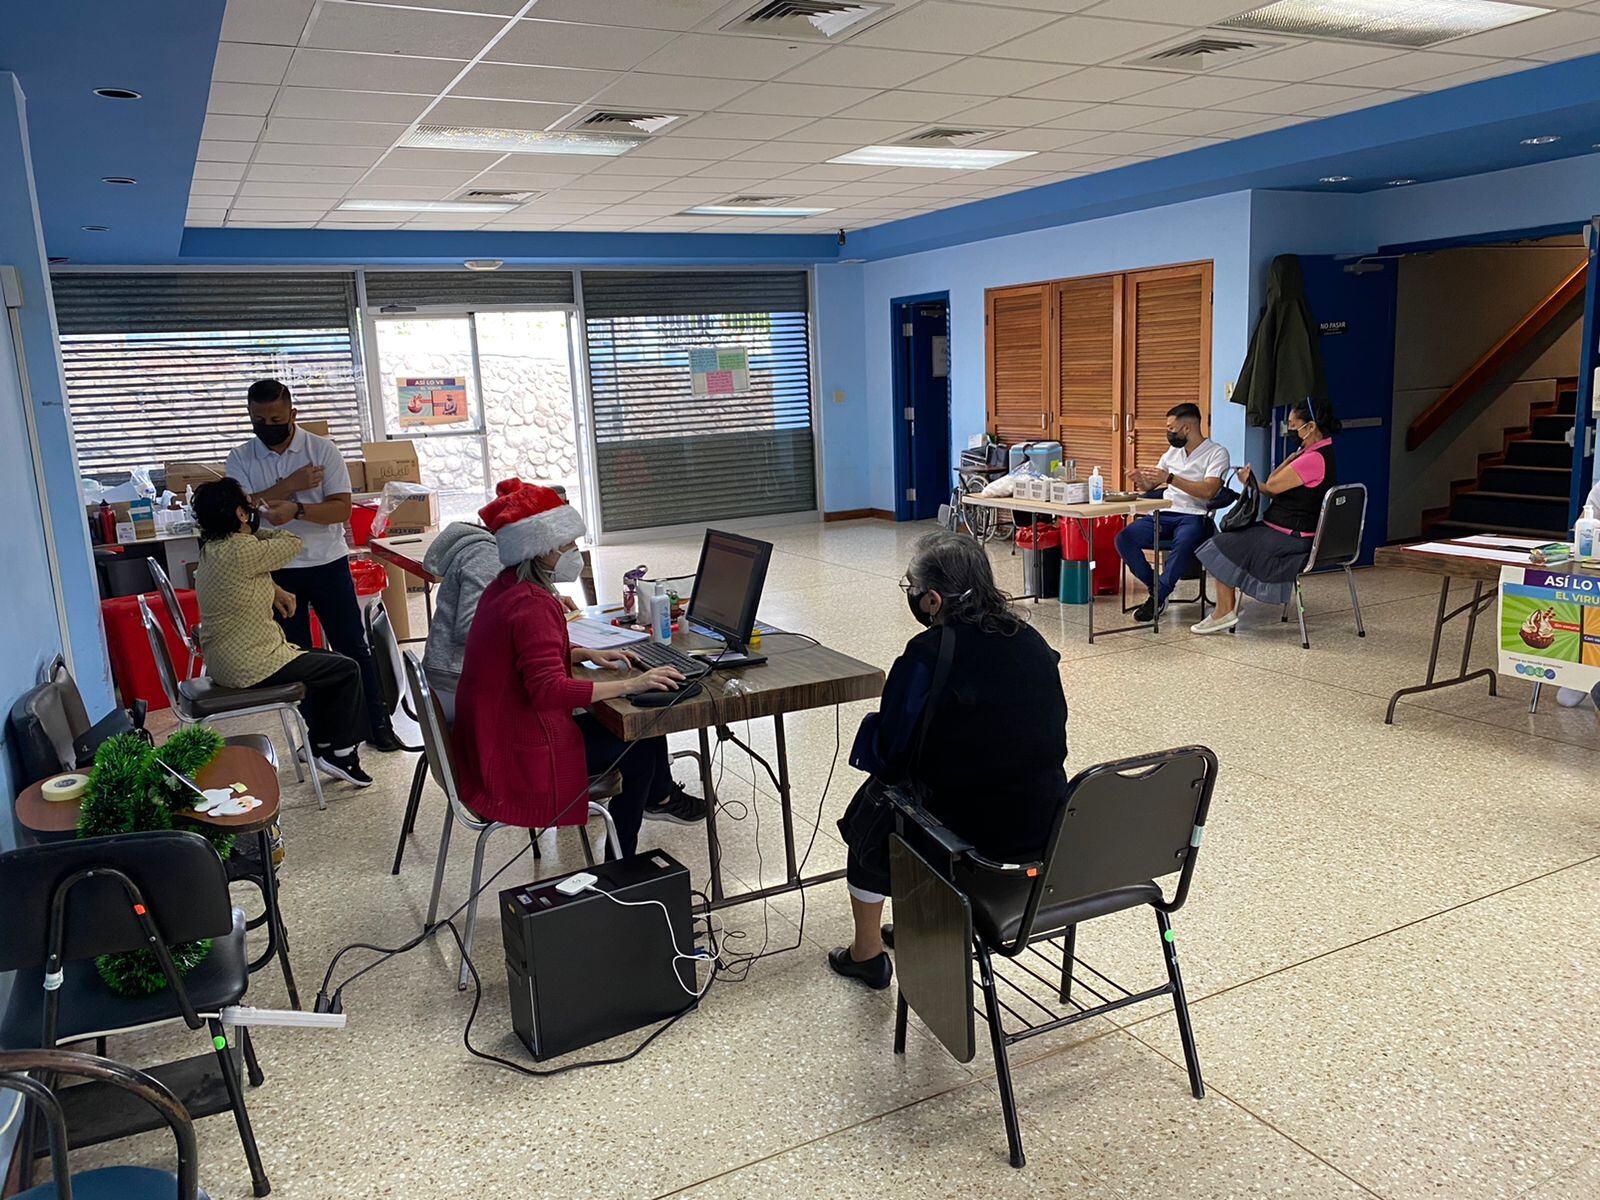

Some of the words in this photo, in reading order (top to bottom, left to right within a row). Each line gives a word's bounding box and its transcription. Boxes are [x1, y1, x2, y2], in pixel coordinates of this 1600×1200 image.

[1544, 575, 1570, 588] ASÍ
[1573, 579, 1593, 591] LO
[1556, 591, 1569, 601] EL
[1572, 593, 1600, 605] VIRU
